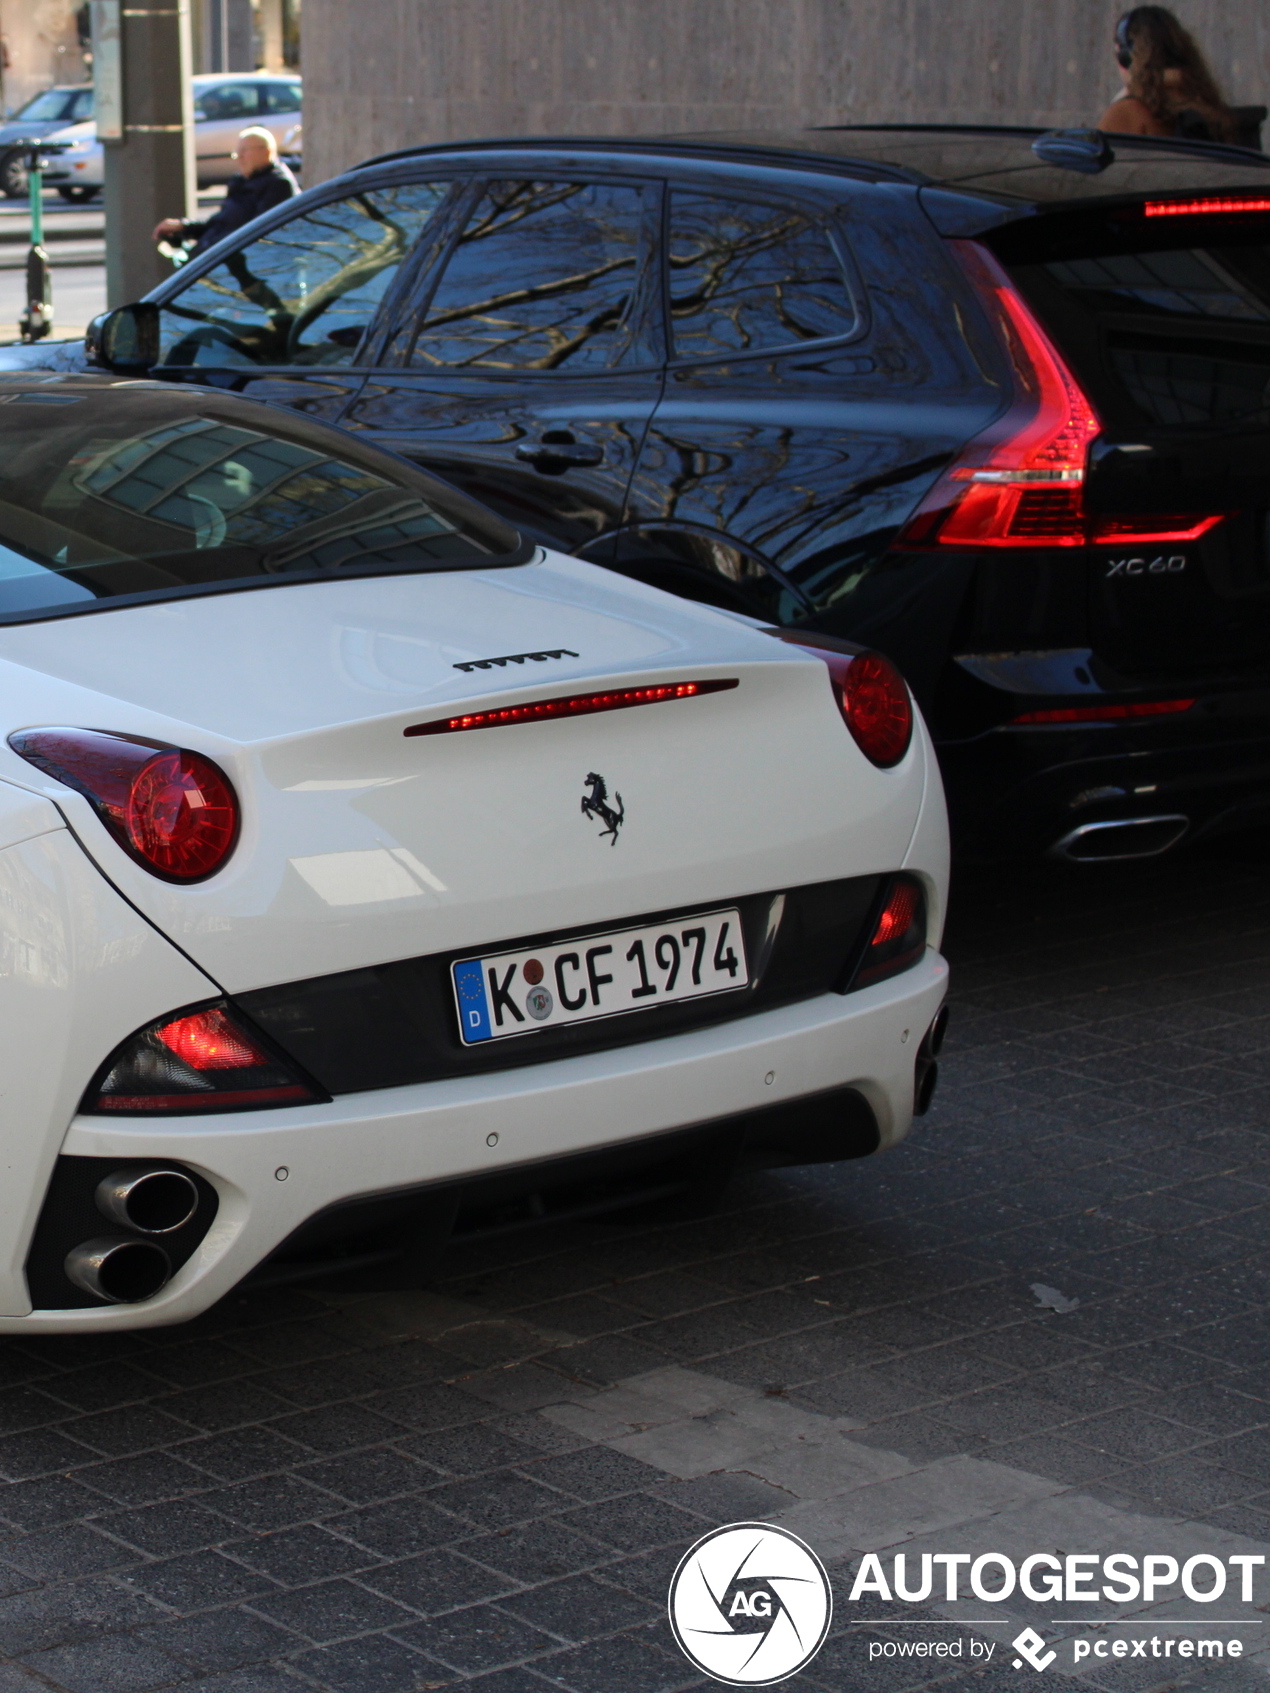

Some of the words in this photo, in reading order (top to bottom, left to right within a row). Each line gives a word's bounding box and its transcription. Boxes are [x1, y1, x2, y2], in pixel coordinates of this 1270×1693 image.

[1105, 556, 1186, 577] XC60
[488, 963, 526, 1026] K
[554, 944, 614, 1011] CF
[626, 921, 739, 998] 1974
[469, 1010, 481, 1028] D
